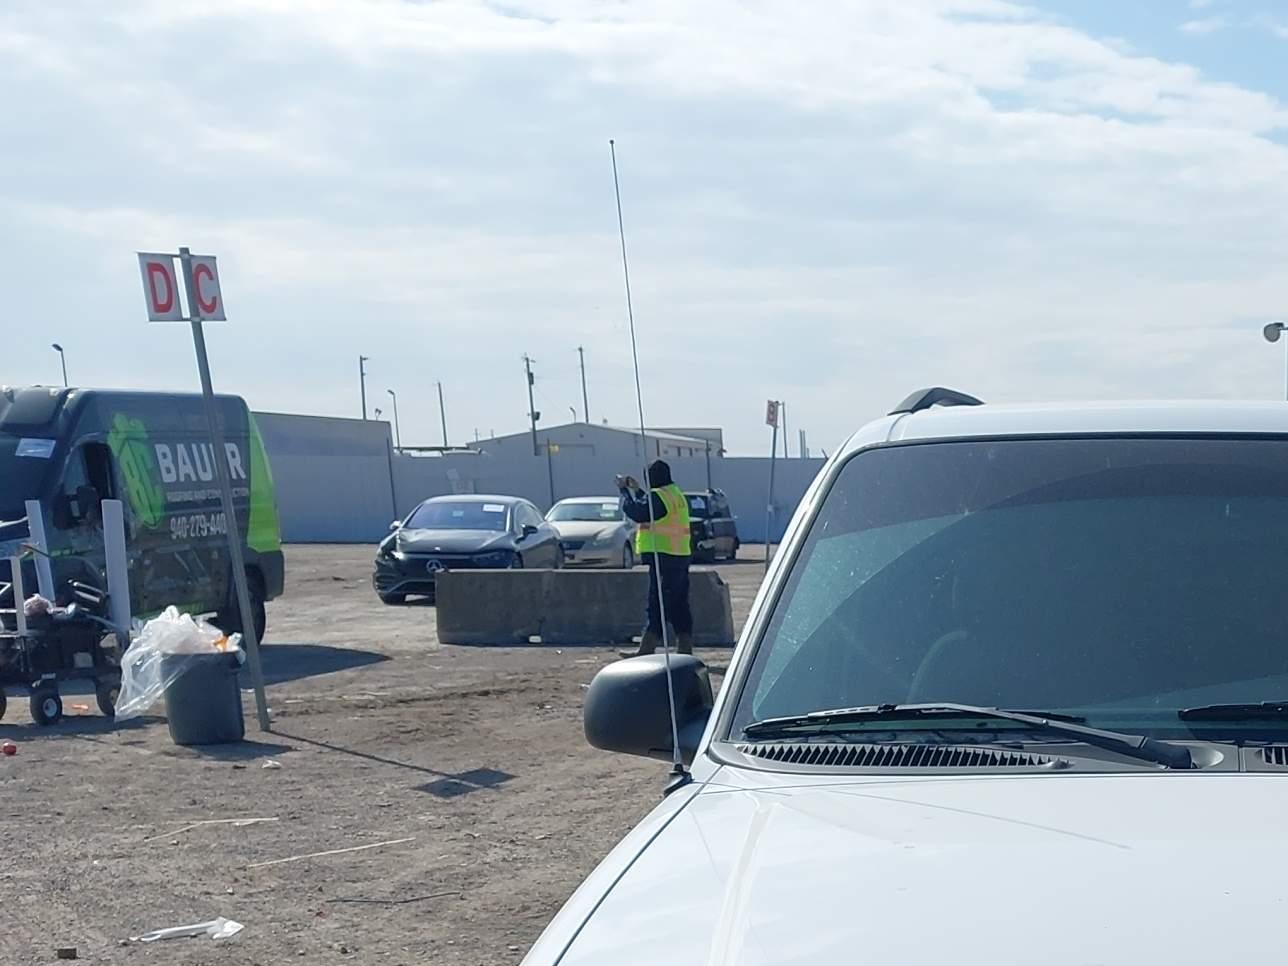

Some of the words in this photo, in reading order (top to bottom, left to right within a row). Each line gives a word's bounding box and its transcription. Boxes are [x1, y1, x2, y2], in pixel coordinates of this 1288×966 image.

[146, 262, 173, 313] D
[192, 263, 217, 314] C
[154, 442, 247, 483] BAUR
[170, 512, 227, 539] 940-279-440
